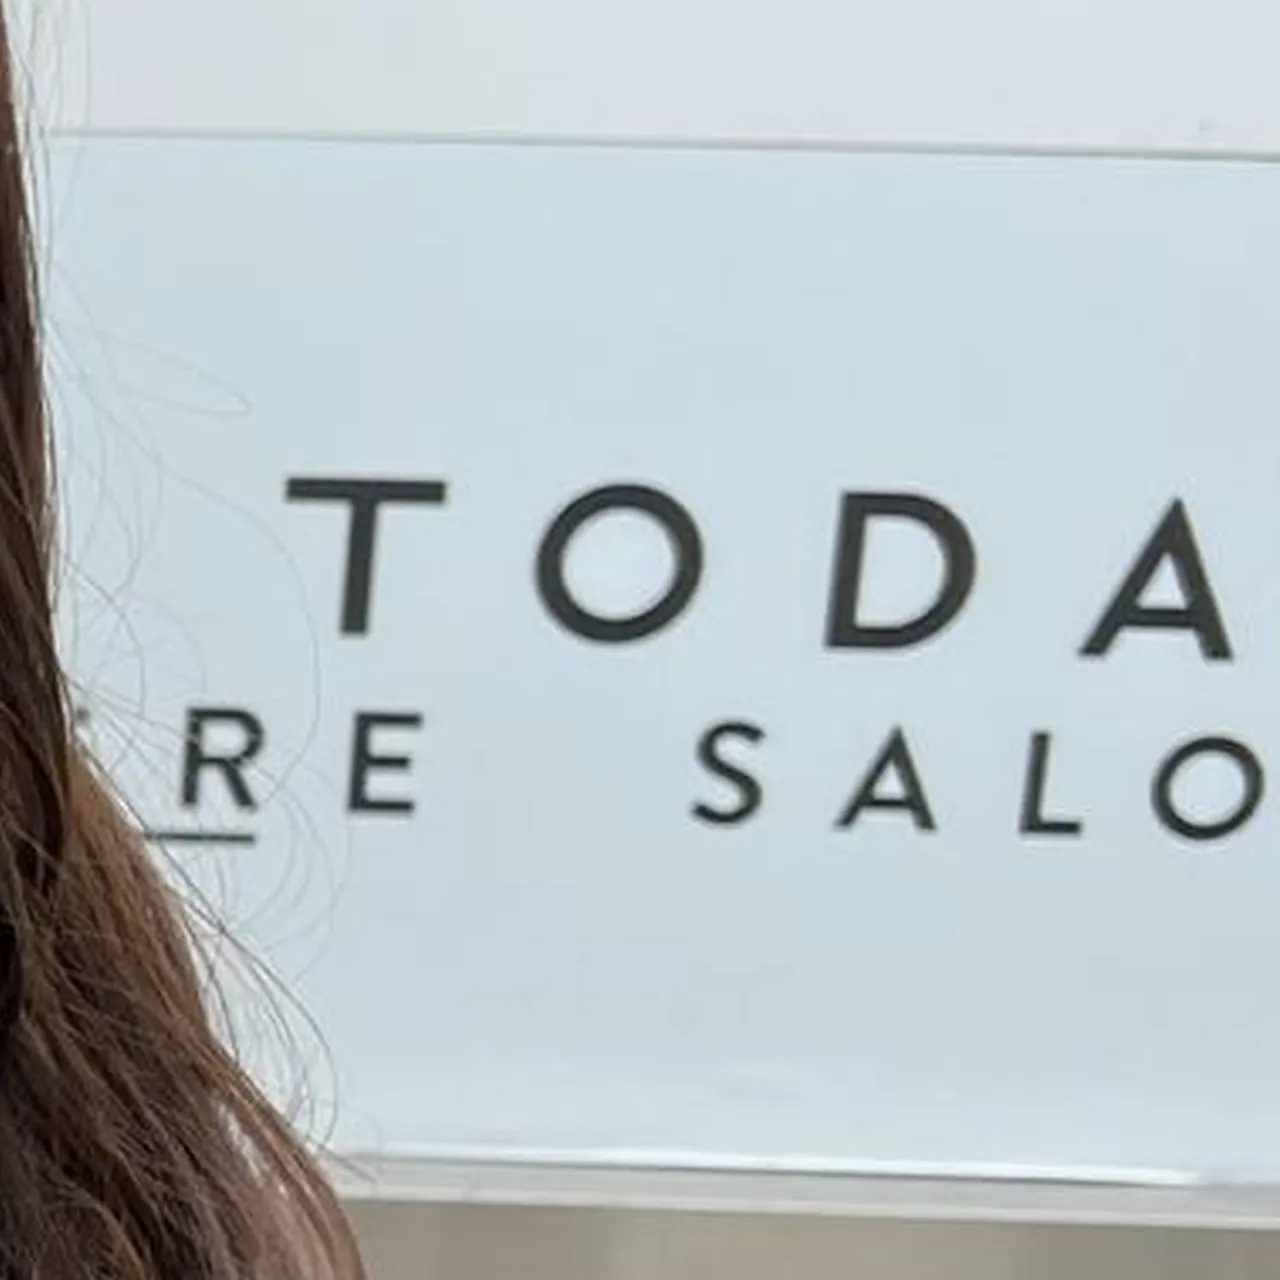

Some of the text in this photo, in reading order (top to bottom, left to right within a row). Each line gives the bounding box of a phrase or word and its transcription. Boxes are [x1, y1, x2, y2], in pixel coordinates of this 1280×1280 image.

[284, 476, 1234, 662] TODA
[76, 705, 1266, 842] RE SALO
